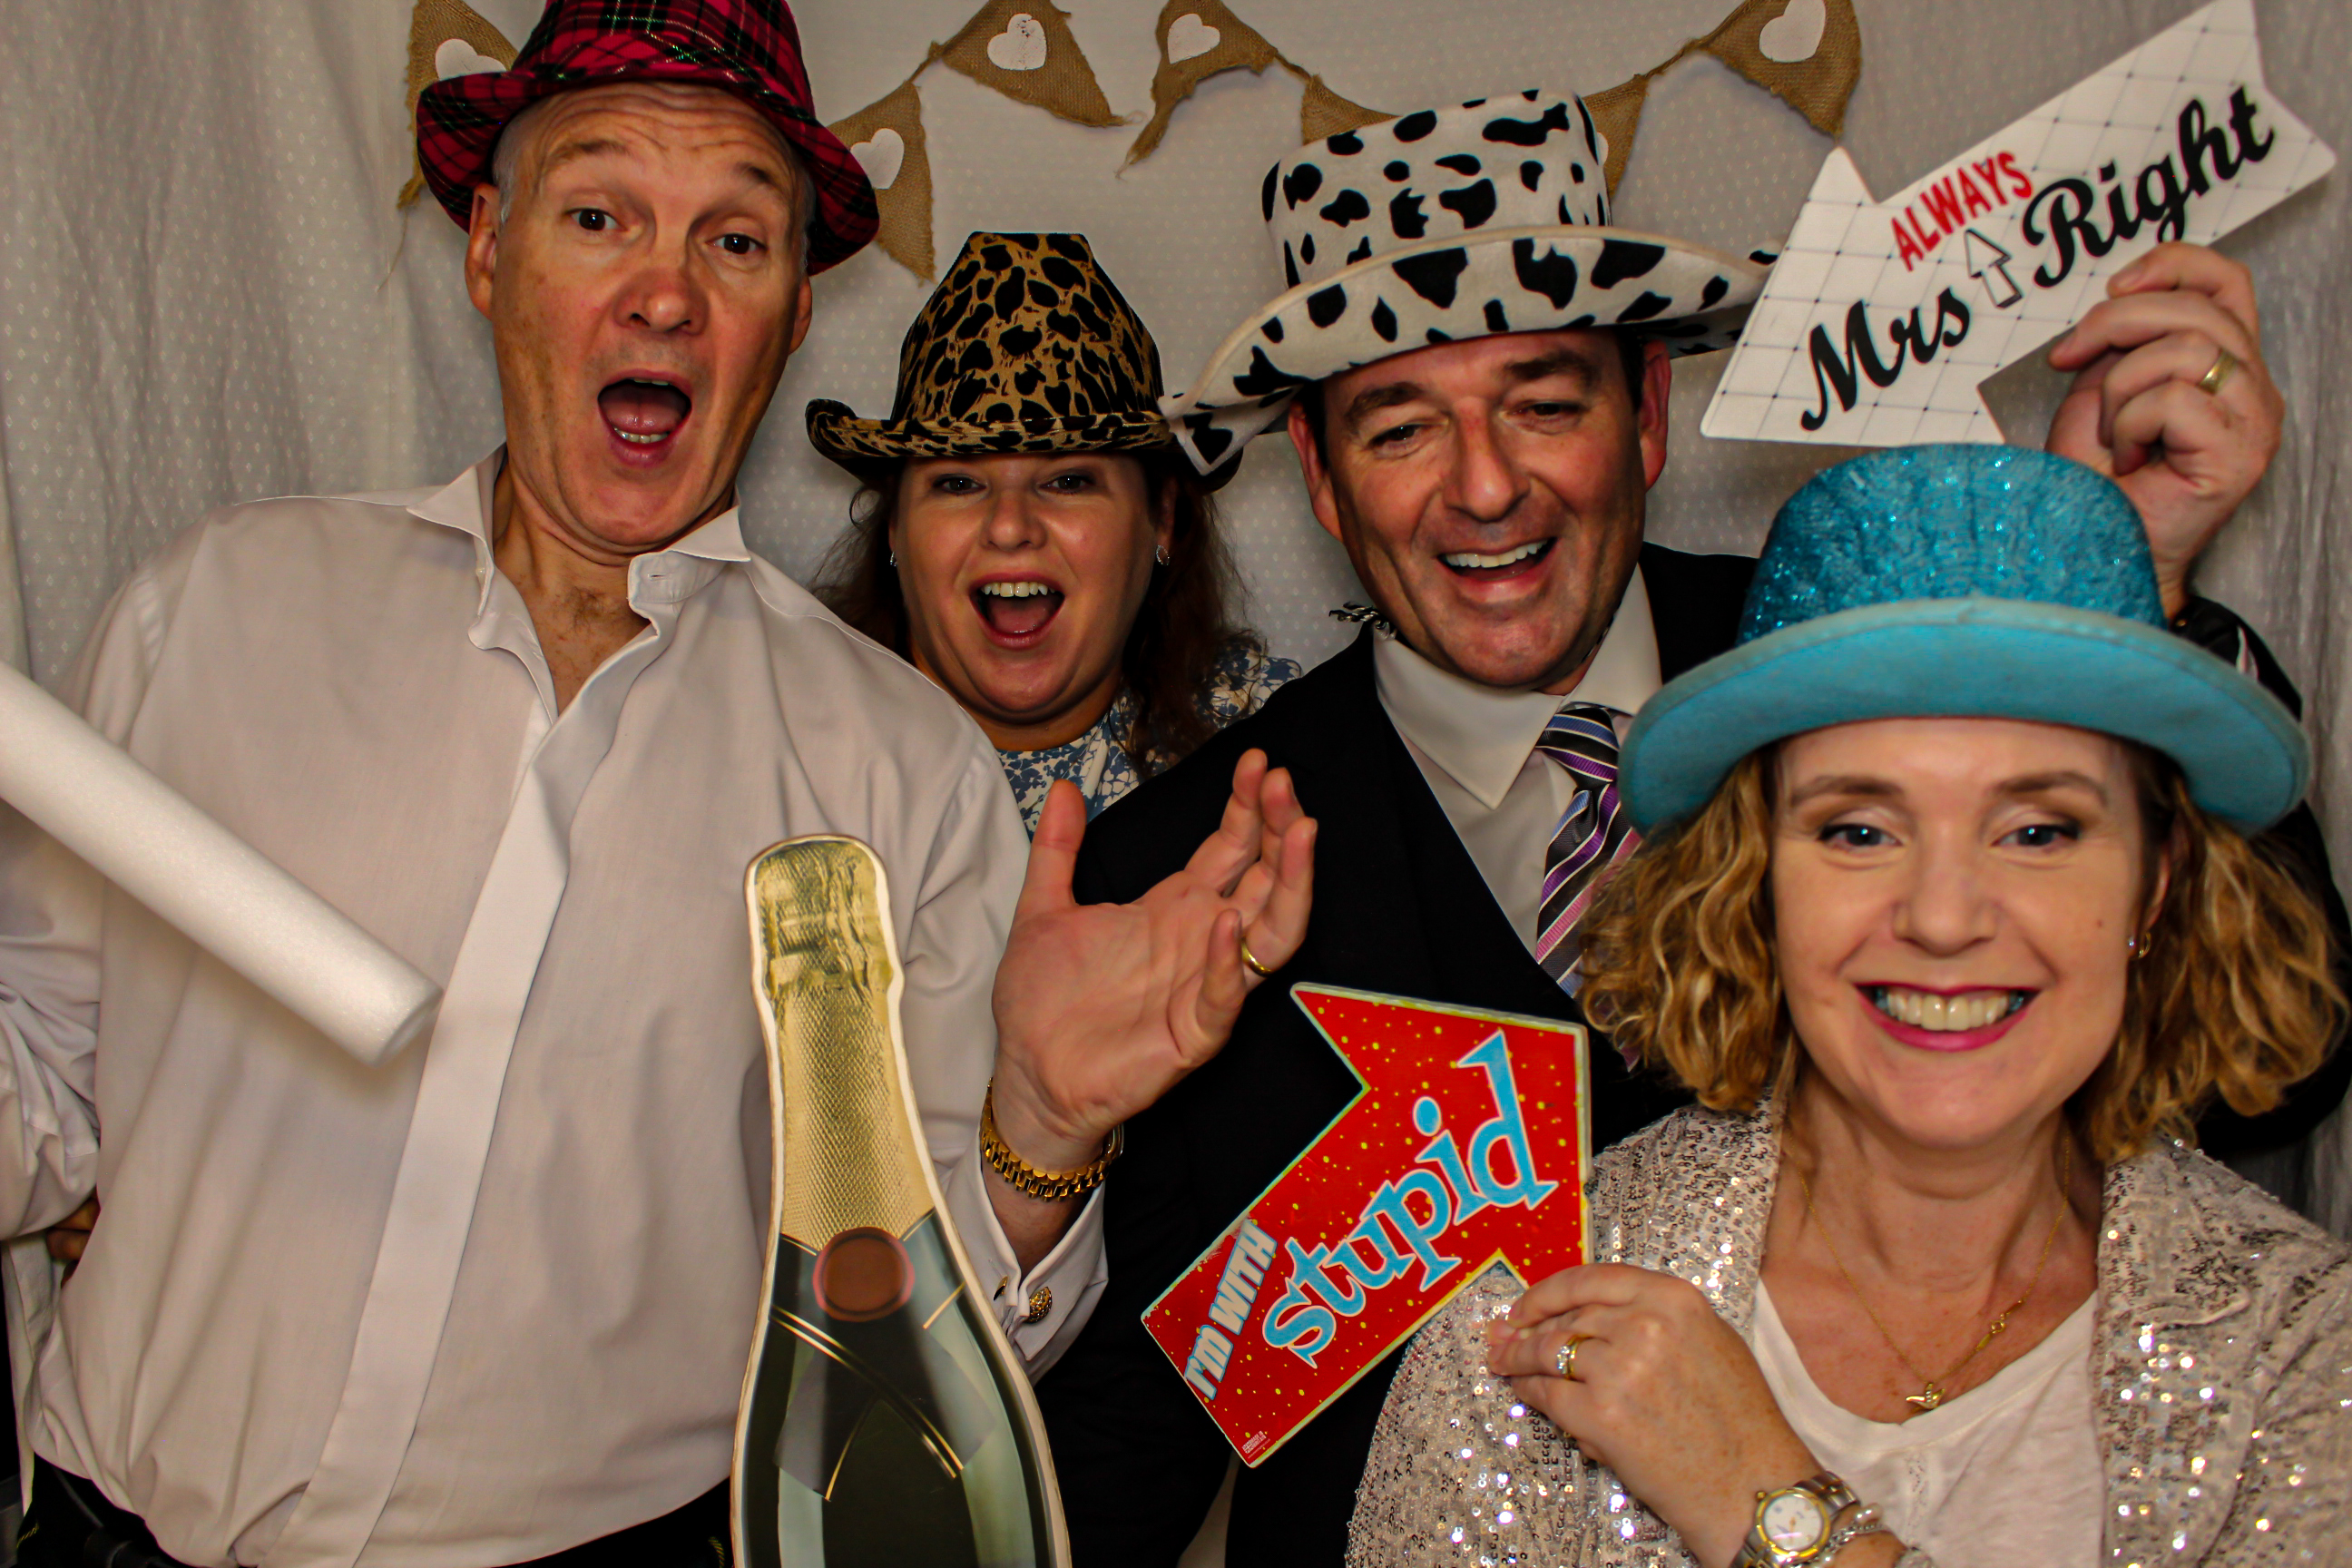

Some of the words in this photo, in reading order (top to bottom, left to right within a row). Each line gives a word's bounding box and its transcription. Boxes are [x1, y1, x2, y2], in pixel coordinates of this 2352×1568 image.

[1800, 286, 1971, 431] Mrs
[2022, 85, 2275, 289] Right
[1890, 151, 2034, 272] ALWAYS
[1208, 1219, 1278, 1336] WITH
[1262, 1030, 1559, 1368] stupid
